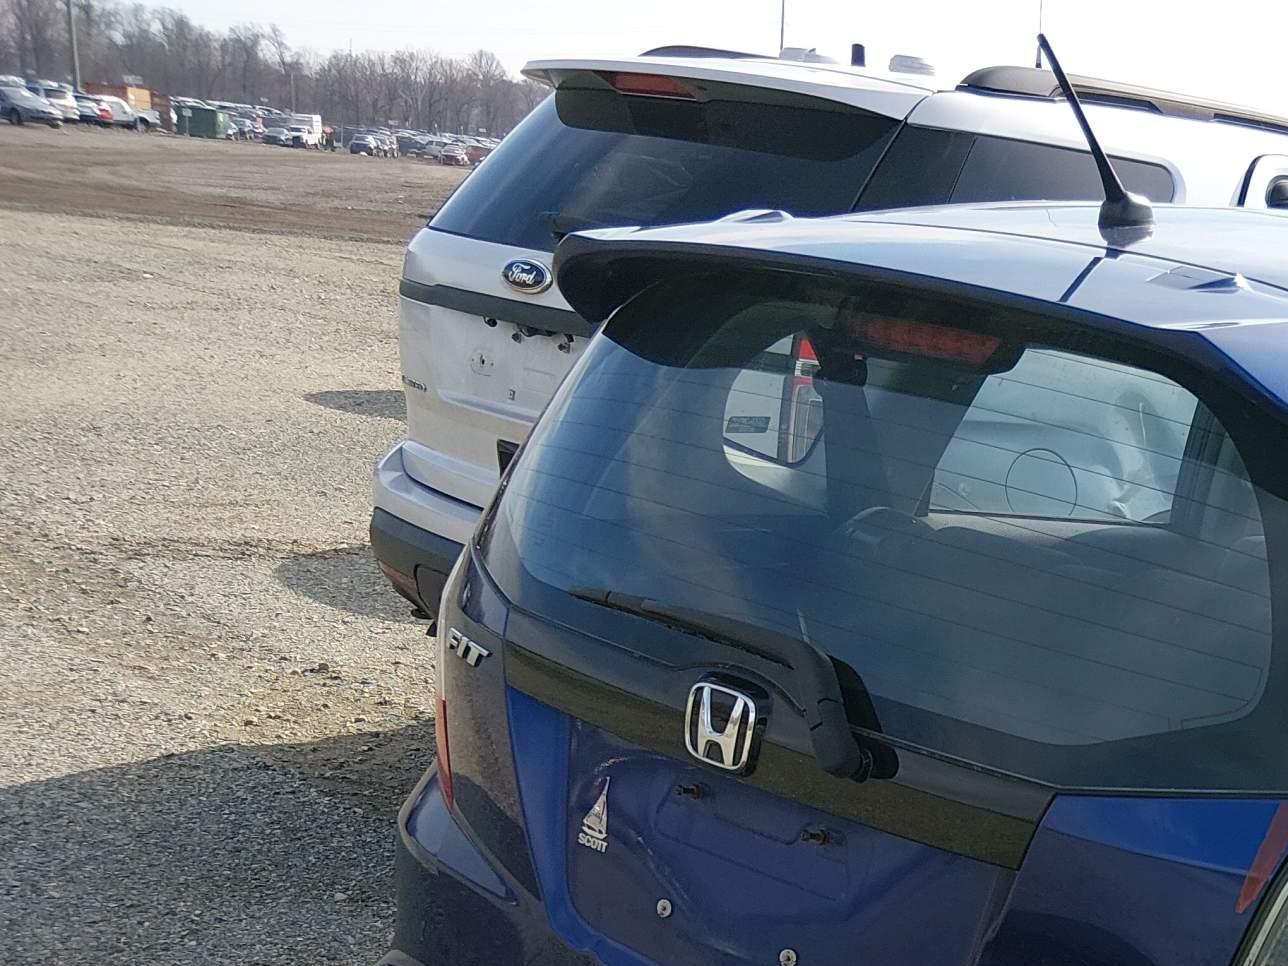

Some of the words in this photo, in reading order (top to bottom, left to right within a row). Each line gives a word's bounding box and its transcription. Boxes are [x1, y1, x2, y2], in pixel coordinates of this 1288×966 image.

[508, 262, 537, 285] Ford
[447, 627, 489, 666] FIT
[577, 832, 608, 853] SCOTT
